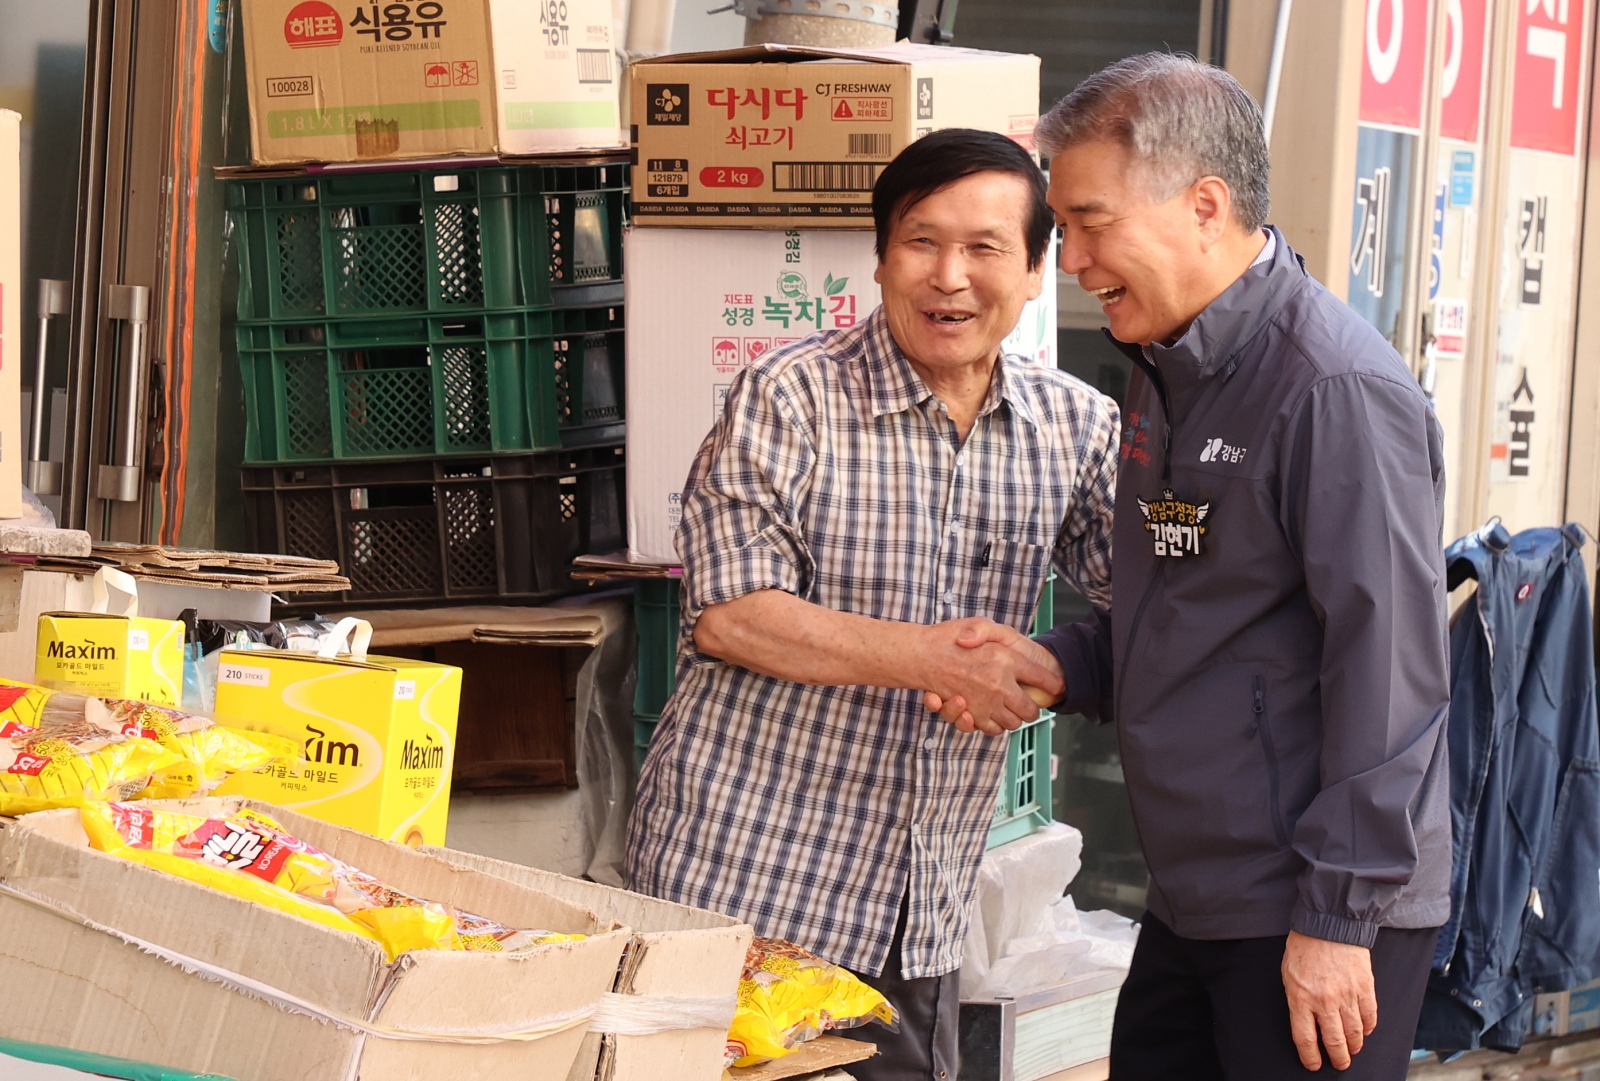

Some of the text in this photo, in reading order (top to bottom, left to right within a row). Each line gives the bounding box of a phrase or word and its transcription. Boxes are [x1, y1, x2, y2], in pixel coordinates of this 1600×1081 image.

[289, 15, 337, 37] 해표
[349, 2, 447, 42] 식용유
[540, 0, 569, 46] 식용유
[360, 45, 375, 53] PURE
[402, 43, 429, 52] SOYBEAN
[430, 42, 441, 51] OIL
[272, 81, 309, 93] 100028
[816, 83, 892, 97] CJ FRESHWAY
[655, 98, 665, 108] CJ
[706, 87, 809, 121] 다시다
[857, 101, 888, 109] 직사광선
[857, 110, 888, 118] 피하세요
[725, 126, 794, 150] 쇠고기
[653, 174, 683, 183] 121879
[717, 170, 749, 185] 2 kg
[656, 186, 680, 195] 6개입
[724, 294, 754, 304] 지도표
[722, 307, 754, 326] 성경
[1222, 444, 1247, 464] 강남구
[1148, 501, 1198, 525] 강남구청장
[1150, 522, 1200, 557] 김현기
[47, 638, 117, 660] Maxim
[56, 662, 105, 671] 모카골드 마일드
[226, 669, 263, 681] 210 STICKS
[400, 733, 444, 770] Maxim
[253, 764, 338, 783] 카골드 마일드
[281, 782, 308, 792] 커피믹스
